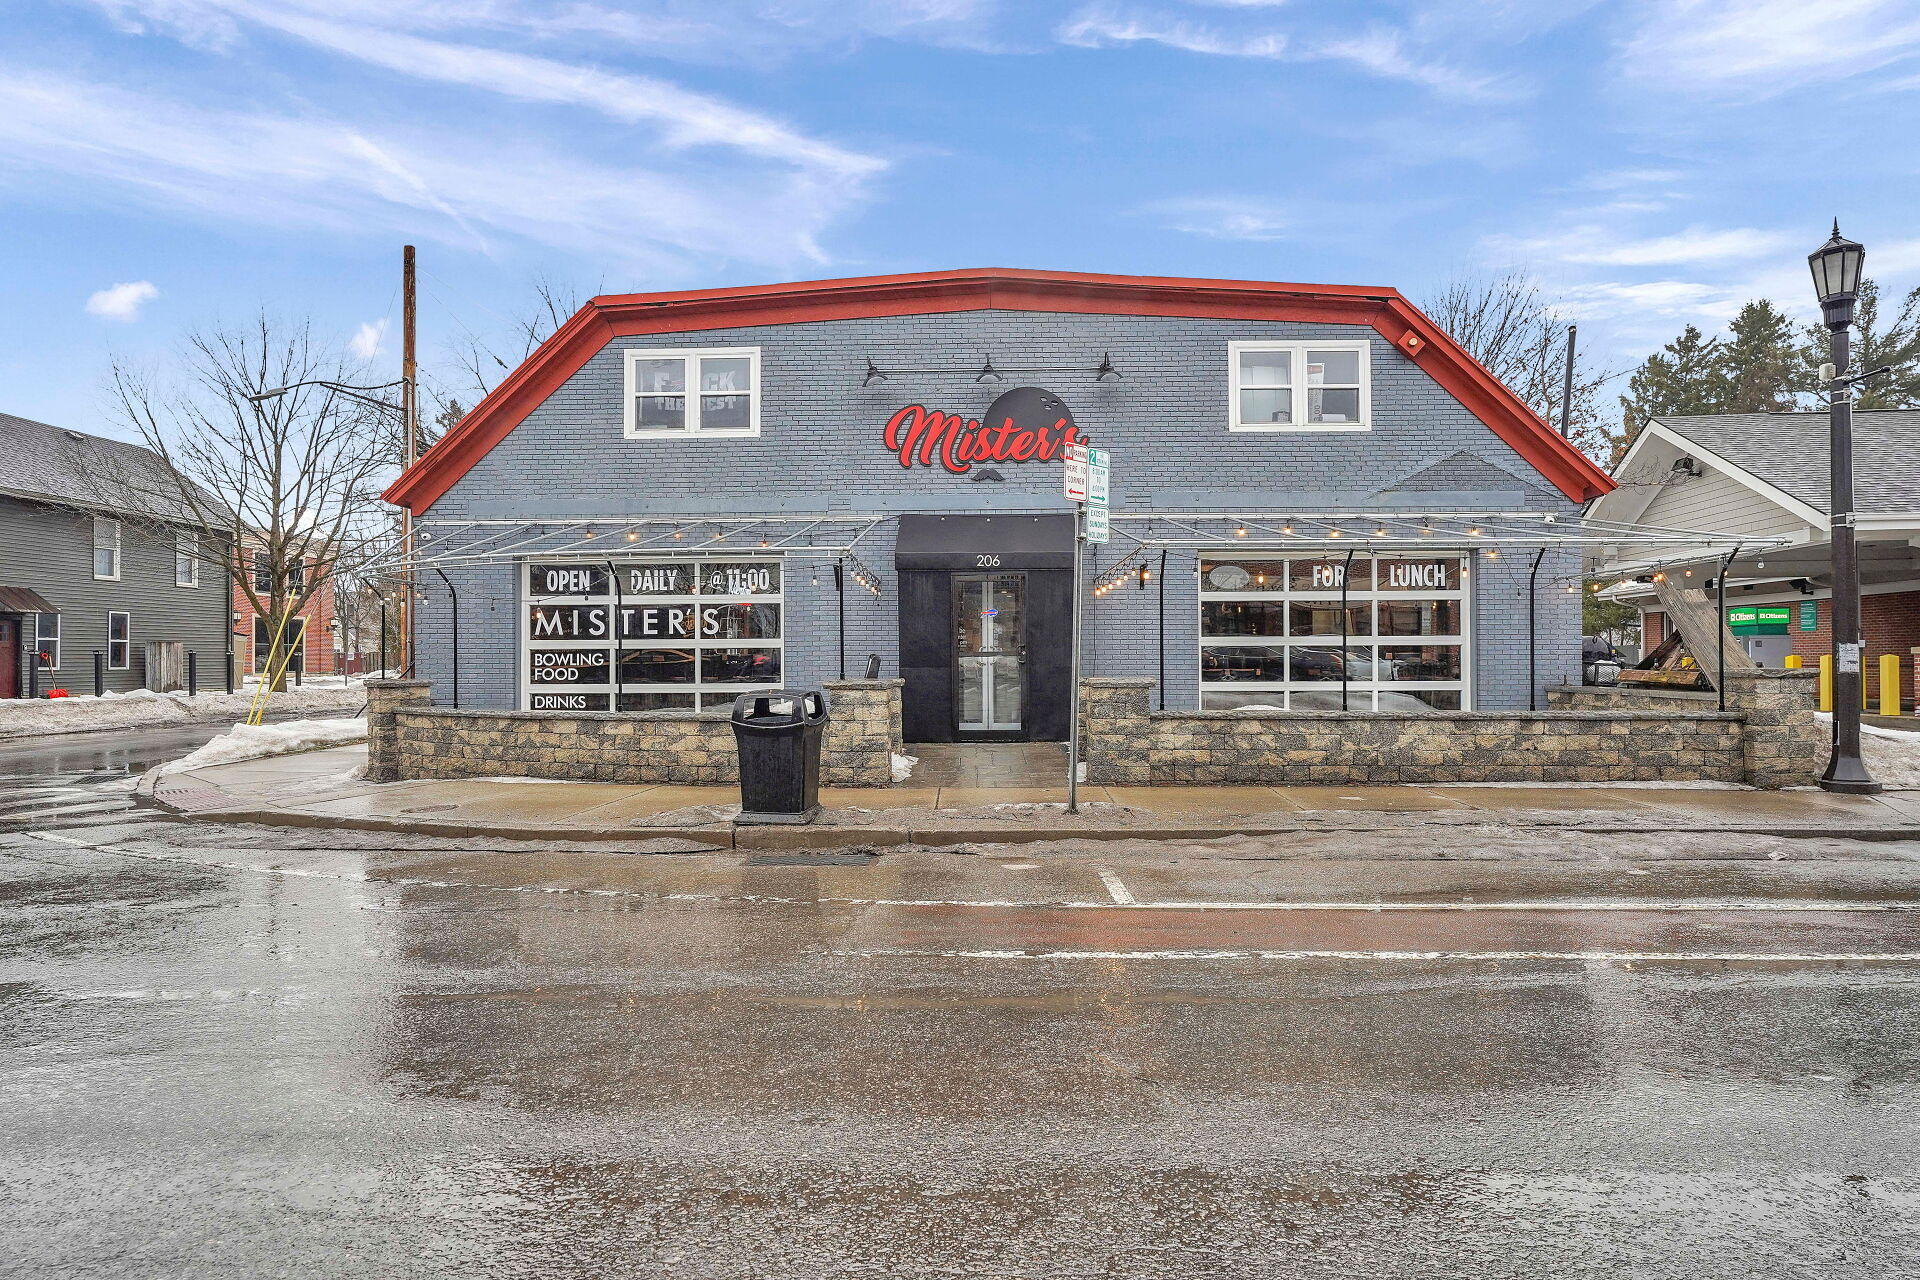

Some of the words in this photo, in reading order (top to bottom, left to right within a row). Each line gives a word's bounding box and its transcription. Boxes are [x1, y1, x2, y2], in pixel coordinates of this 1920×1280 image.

[654, 370, 736, 392] FCK
[884, 404, 1089, 474] Mister's
[1090, 450, 1096, 464] 2
[1066, 464, 1078, 473] HERE
[1080, 466, 1087, 475] TO
[1067, 475, 1085, 486] CORNER
[1090, 510, 1106, 519] EXCEPT
[976, 554, 1001, 567] 206
[546, 570, 591, 592] OPEN
[631, 569, 677, 592] DAILY
[711, 570, 724, 590] @
[726, 568, 770, 592] 11:00
[1313, 564, 1345, 588] FOR
[1389, 564, 1446, 588] LUNCH
[534, 608, 720, 636] MISTER'S
[534, 653, 604, 667] BOWLING
[534, 668, 579, 682] FOOD
[534, 696, 587, 709] DRINKS
